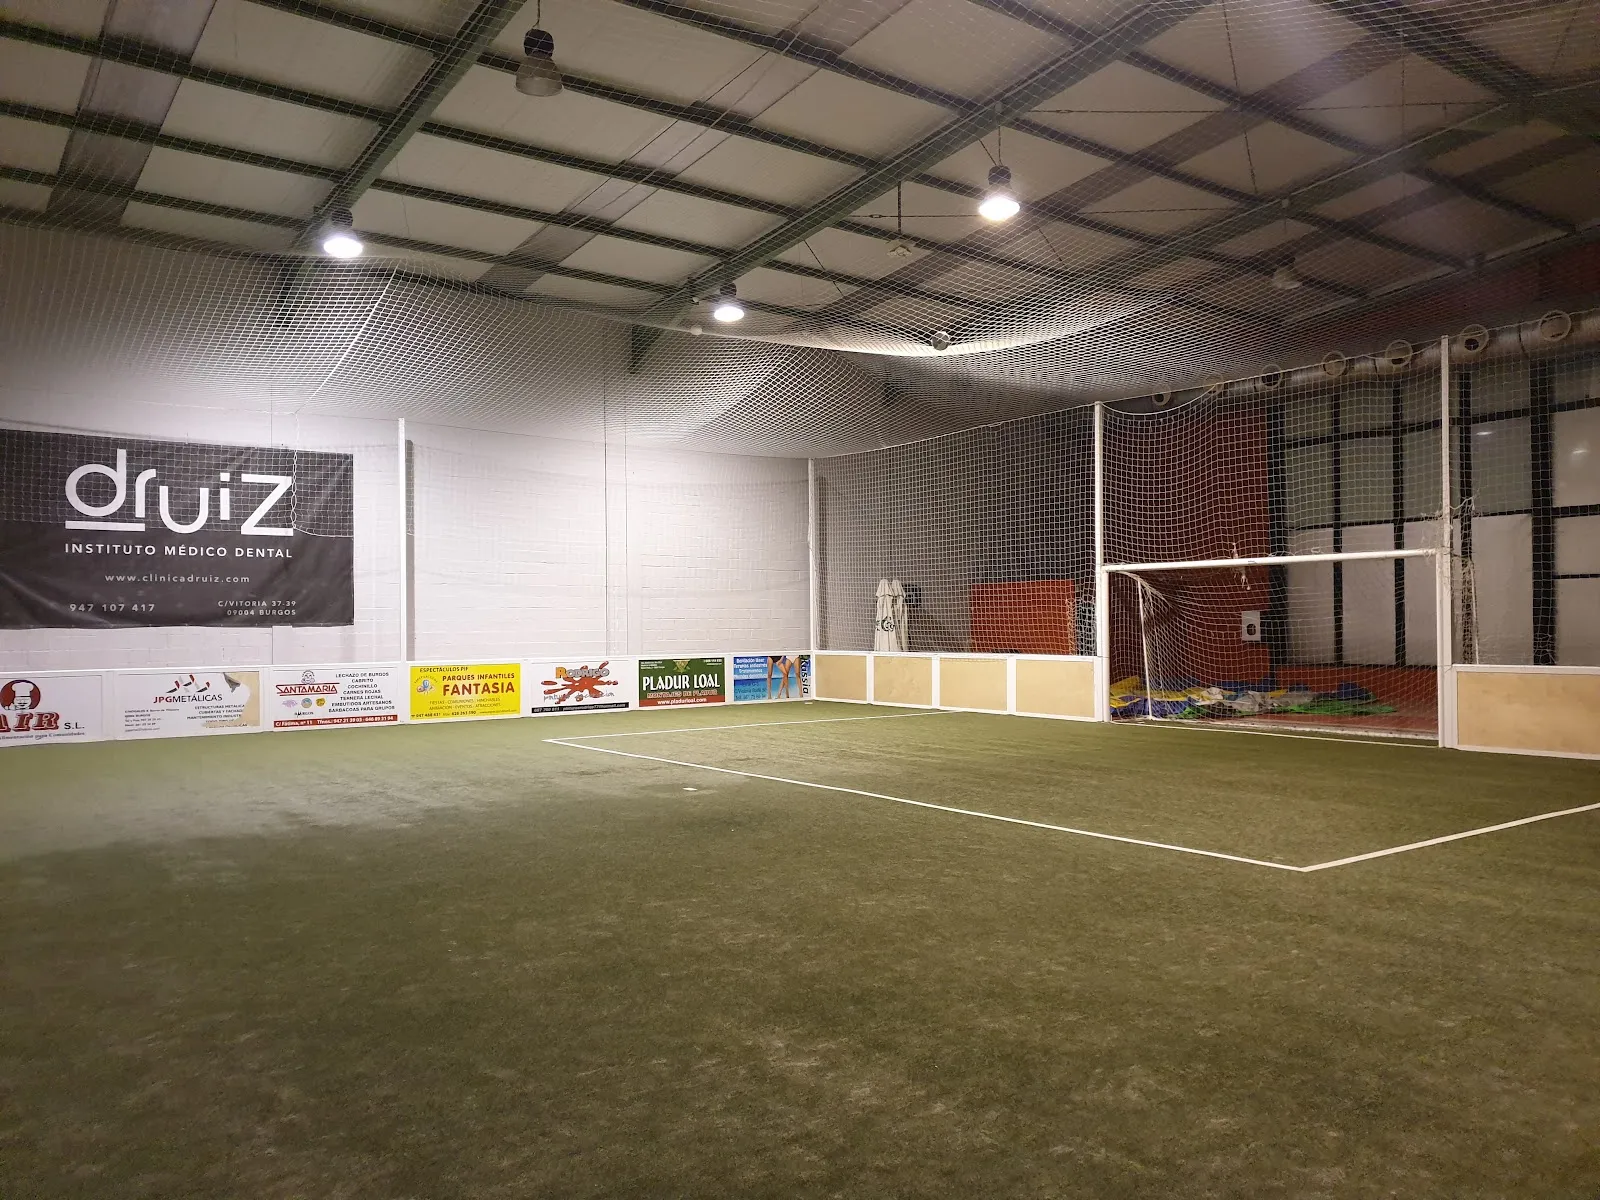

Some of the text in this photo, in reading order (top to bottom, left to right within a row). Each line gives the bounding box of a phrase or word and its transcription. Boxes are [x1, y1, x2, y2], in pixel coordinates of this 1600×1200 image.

[65, 449, 294, 536] druiz
[65, 543, 293, 558] INSTITUTO MÉDICO DENTAL
[105, 573, 250, 583] www.clinicadruiz.com
[69, 603, 155, 612] 947 107 417
[218, 600, 297, 608] C/VITORIA 37-39
[442, 674, 475, 682] PARQUES
[477, 672, 515, 680] INFANTILES
[642, 673, 720, 691] PLADUR LOAL
[276, 684, 338, 695] SANTAMARIA
[443, 681, 515, 697] FANTASIA
[153, 693, 223, 704] JPGMETÁLICAS
